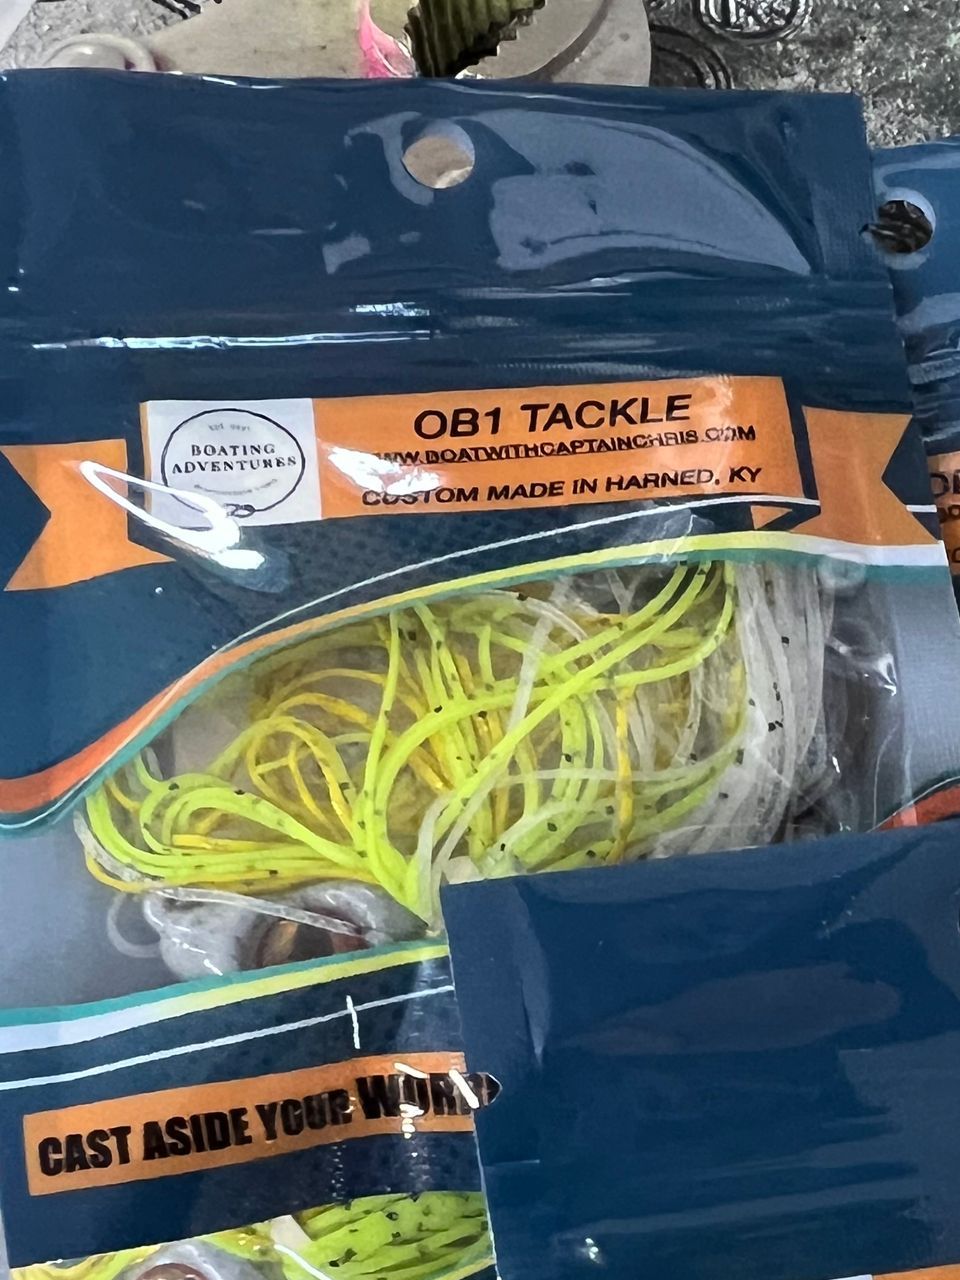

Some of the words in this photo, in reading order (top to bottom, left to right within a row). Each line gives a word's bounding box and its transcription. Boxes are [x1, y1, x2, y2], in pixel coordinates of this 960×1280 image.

[413, 407, 502, 440] OB1
[520, 394, 692, 433] TACKLE
[172, 456, 297, 474] ADVENTURES
[191, 444, 276, 456] BOATING
[487, 479, 564, 501] MADE
[572, 478, 598, 494] IN
[605, 468, 720, 491] HARNED,
[728, 466, 762, 483] KY
[38, 1126, 131, 1177] CAST
[142, 1107, 252, 1161] ASIDE
[254, 1088, 352, 1142] YOUR
